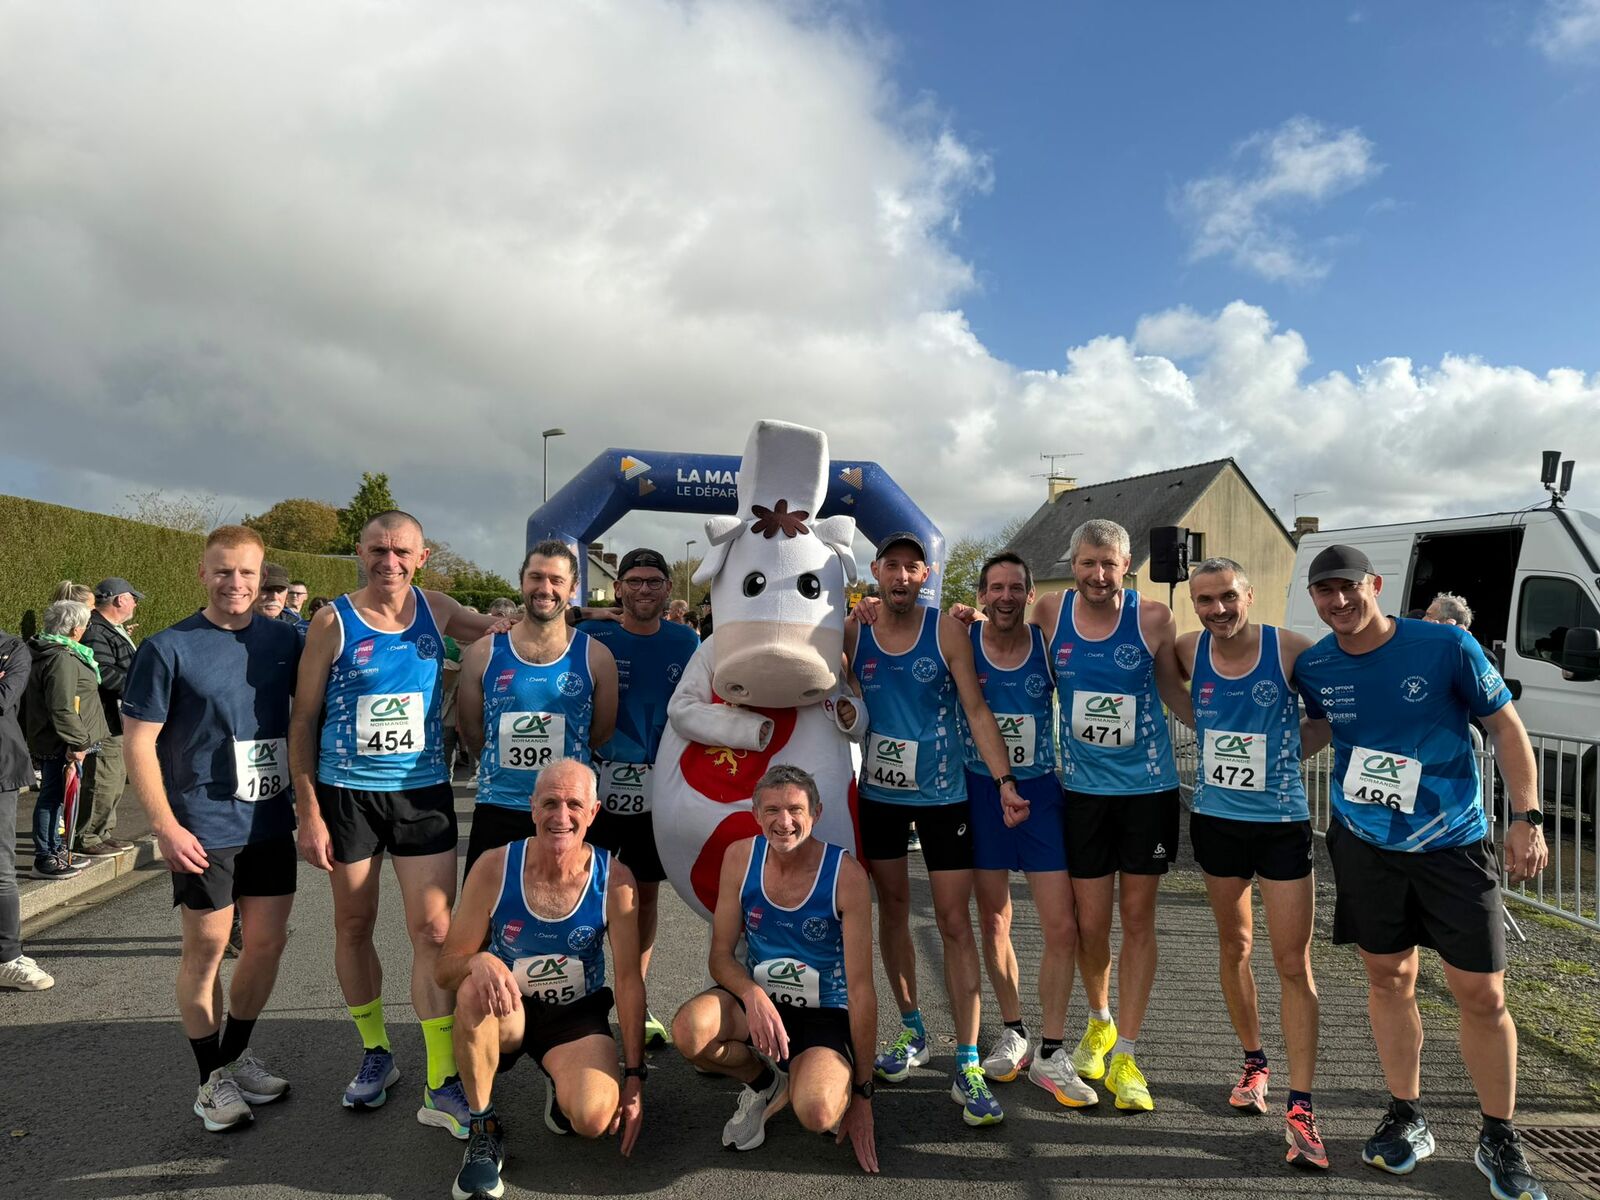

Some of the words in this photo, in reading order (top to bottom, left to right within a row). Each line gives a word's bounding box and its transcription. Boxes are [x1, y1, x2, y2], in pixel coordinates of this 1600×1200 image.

[677, 468, 701, 483] LA
[677, 486, 691, 496] LE
[1084, 716, 1120, 724] NORMANDIE
[367, 730, 415, 752] 454
[1081, 725, 1122, 746] 471
[508, 746, 553, 768] 398
[1007, 745, 1025, 764] 8
[1214, 755, 1251, 764] NORMANDIE
[876, 759, 904, 768] NORMANDIE
[874, 766, 909, 788] 442
[1212, 765, 1255, 788] 472
[1359, 776, 1400, 789] NORMANDIE
[247, 774, 281, 798] 168
[606, 793, 644, 812] 628
[506, 924, 522, 932] PNEU
[528, 979, 569, 988] NORMANDIE
[767, 983, 804, 992] NORMANDIE
